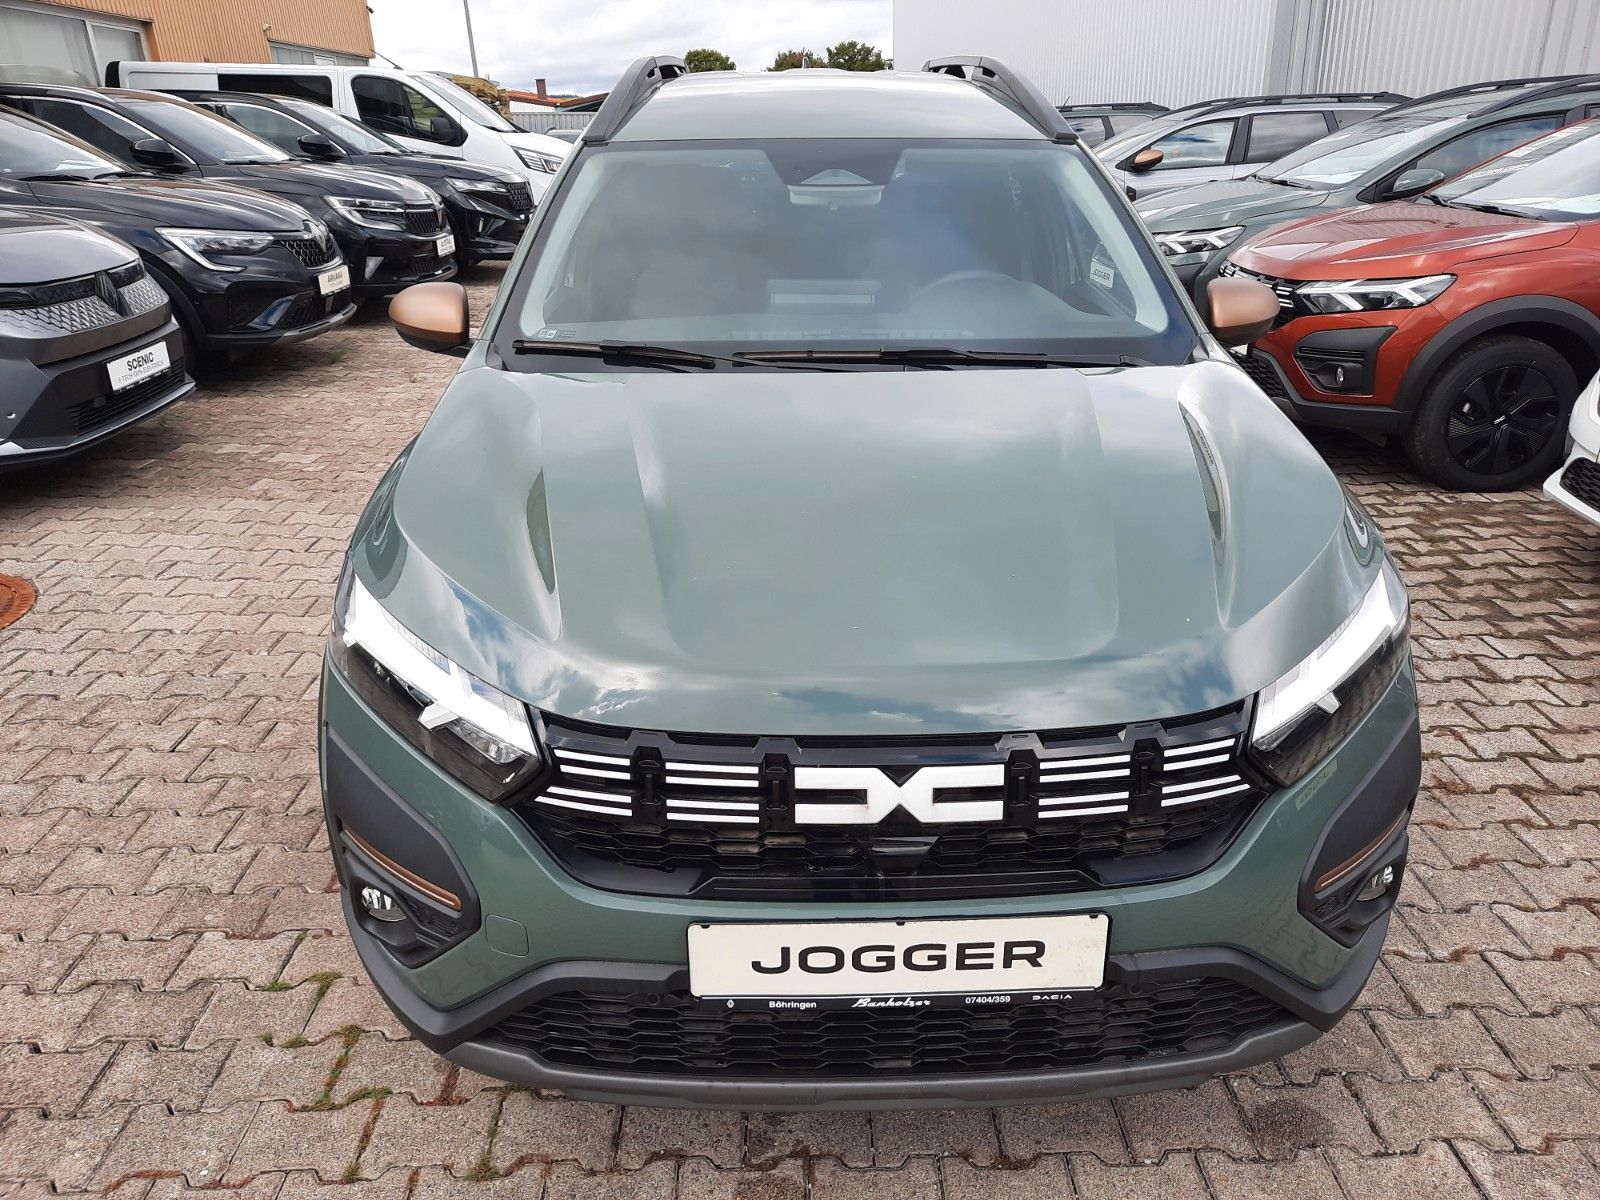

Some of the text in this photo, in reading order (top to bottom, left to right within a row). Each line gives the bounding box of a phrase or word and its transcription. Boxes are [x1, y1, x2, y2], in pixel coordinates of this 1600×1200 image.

[126, 352, 154, 371] SCENIC
[751, 939, 1046, 975] JOGGER
[768, 1000, 817, 1010] Böhringen
[851, 997, 932, 1008] Banholzer
[965, 995, 1011, 1004] 07404/359
